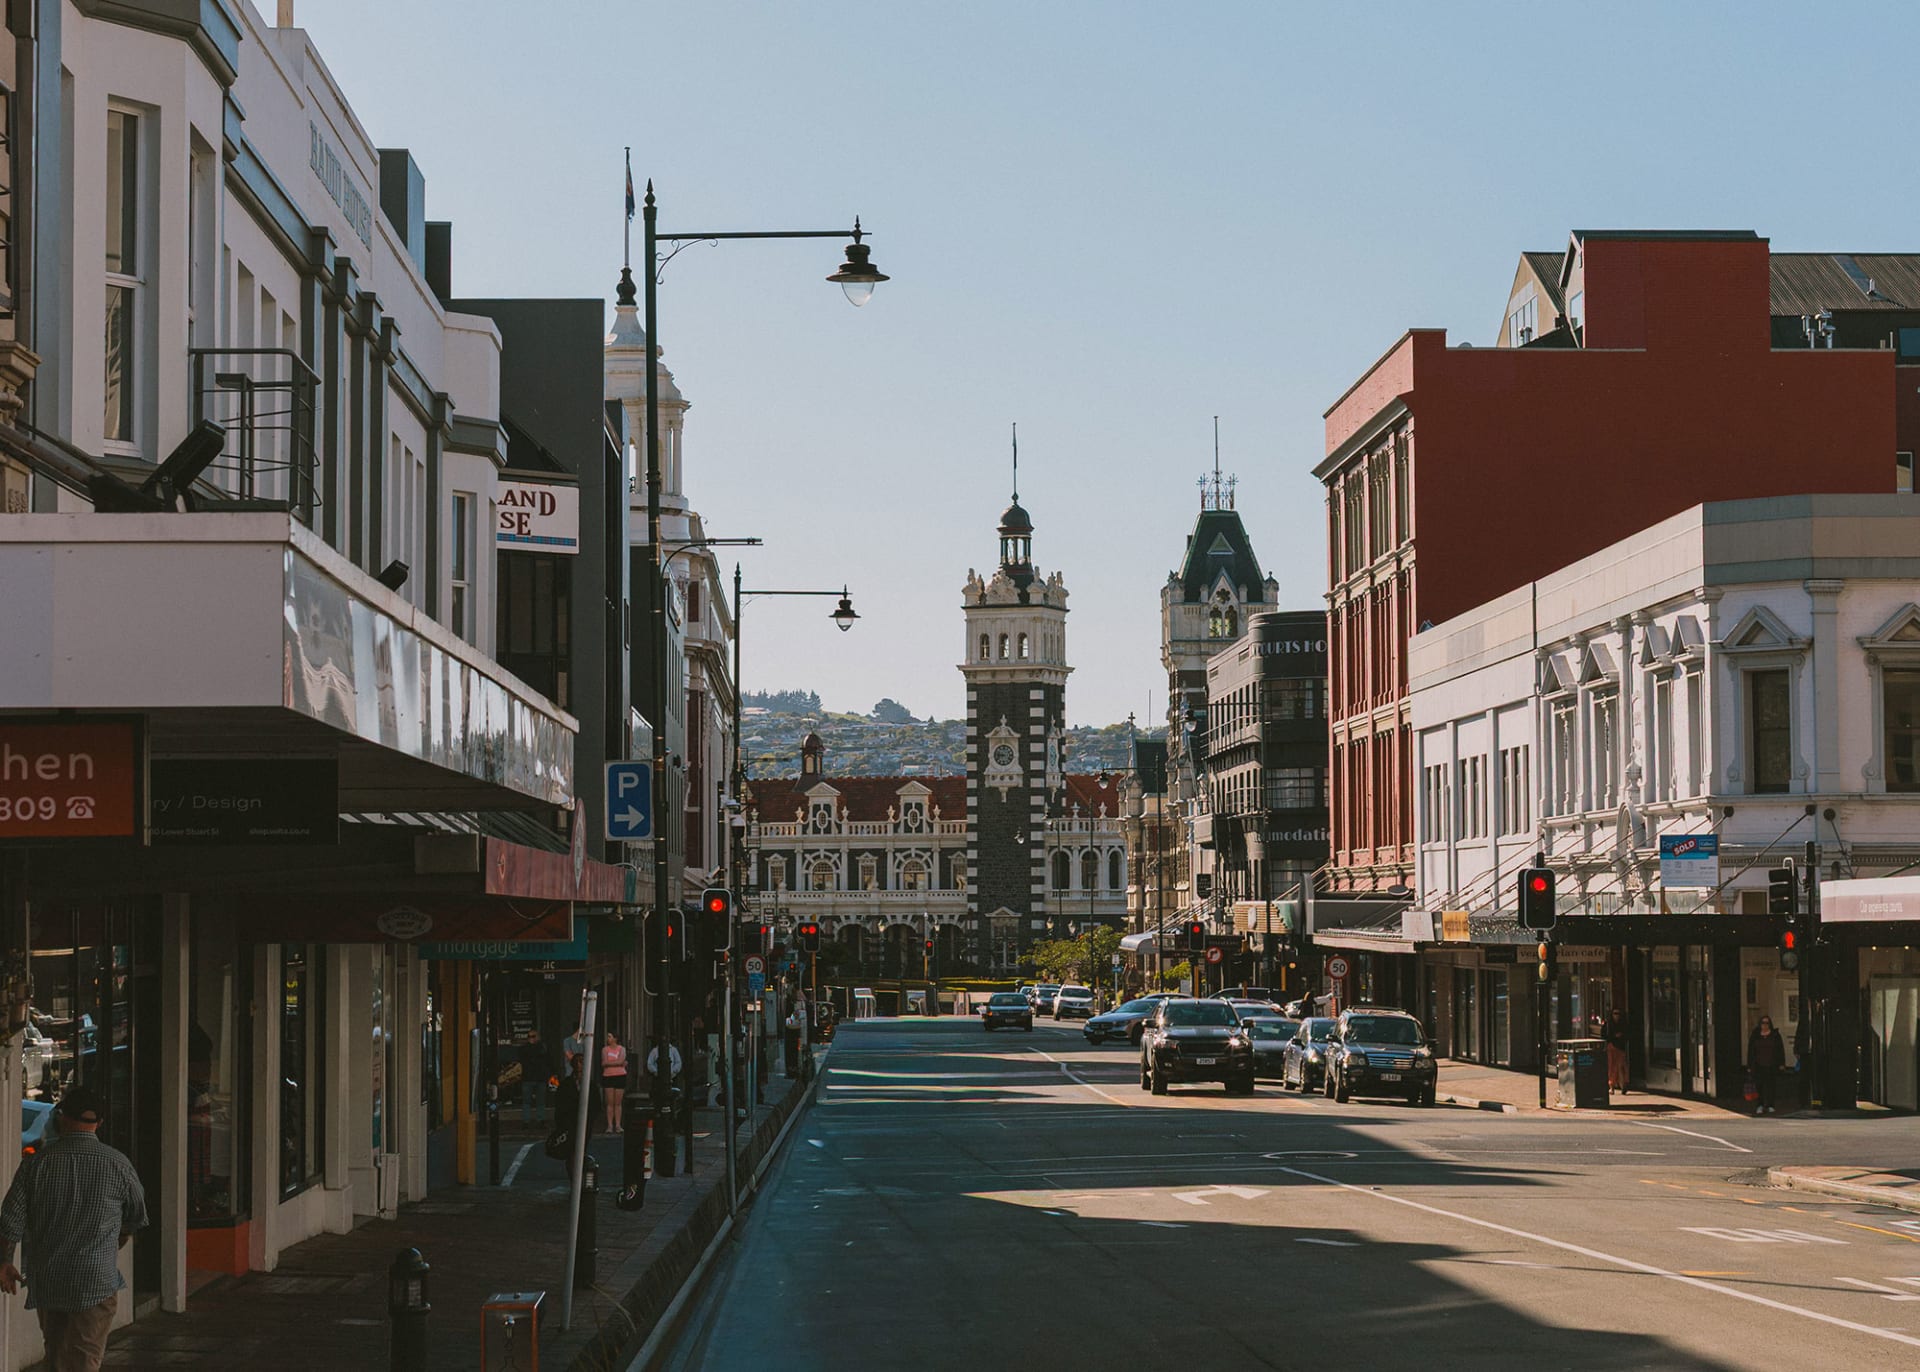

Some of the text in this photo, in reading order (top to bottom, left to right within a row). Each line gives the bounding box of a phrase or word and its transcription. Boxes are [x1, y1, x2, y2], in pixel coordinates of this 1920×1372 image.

[497, 489, 556, 516] AND
[4, 743, 94, 781] hen
[618, 772, 639, 799] P
[192, 795, 262, 812] Design
[1673, 840, 1695, 855] SOLD
[1581, 947, 1604, 957] café
[748, 961, 762, 971] 50
[1332, 963, 1346, 973] 50
